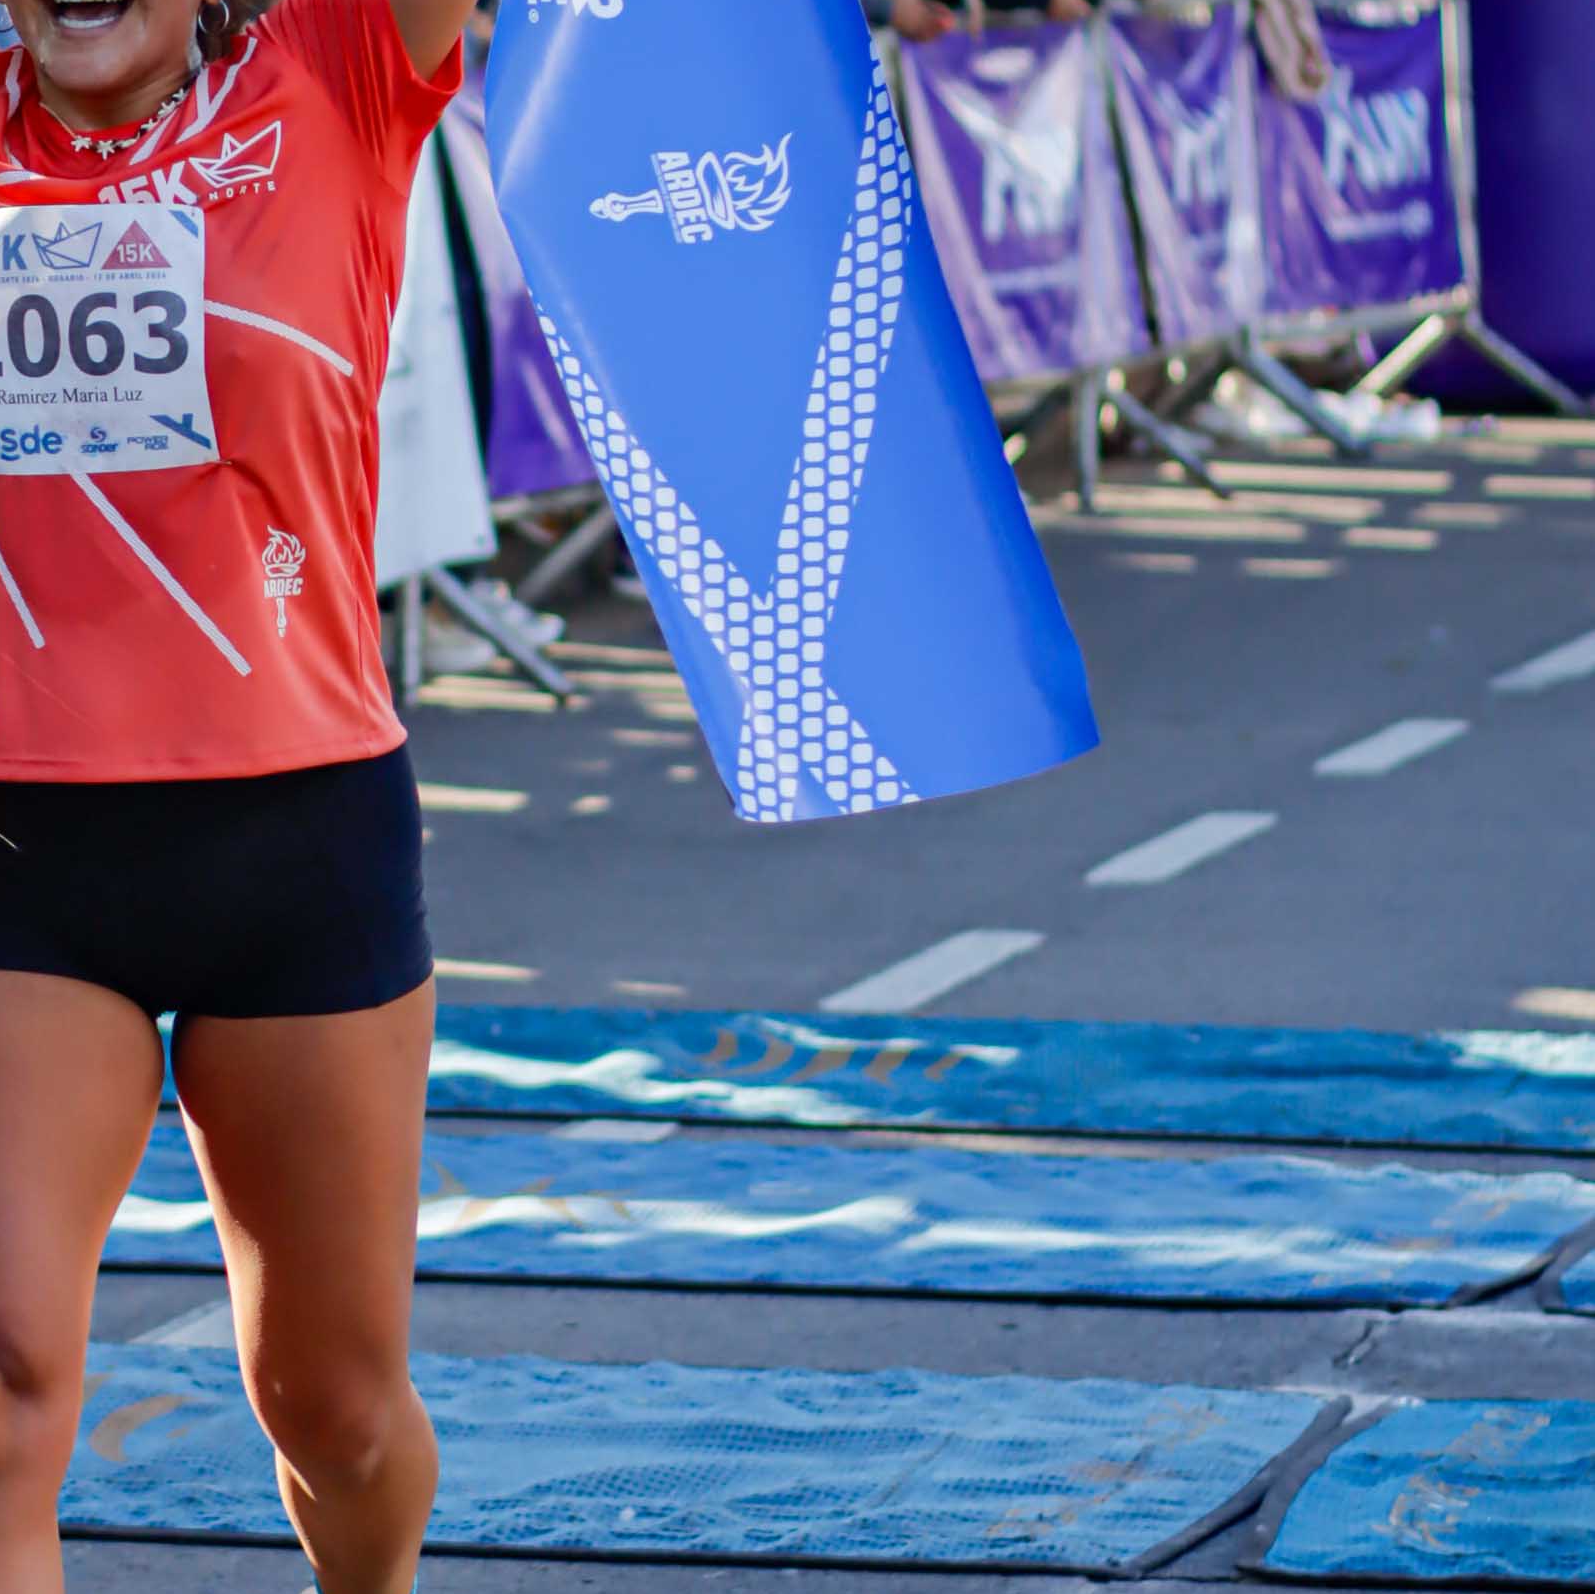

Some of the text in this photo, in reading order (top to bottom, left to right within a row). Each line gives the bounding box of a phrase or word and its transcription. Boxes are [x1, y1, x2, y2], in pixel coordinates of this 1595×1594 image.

[657, 152, 712, 243] ARDEC
[115, 242, 155, 265] 15K
[63, 388, 107, 403] Maria
[114, 386, 143, 402] Luz
